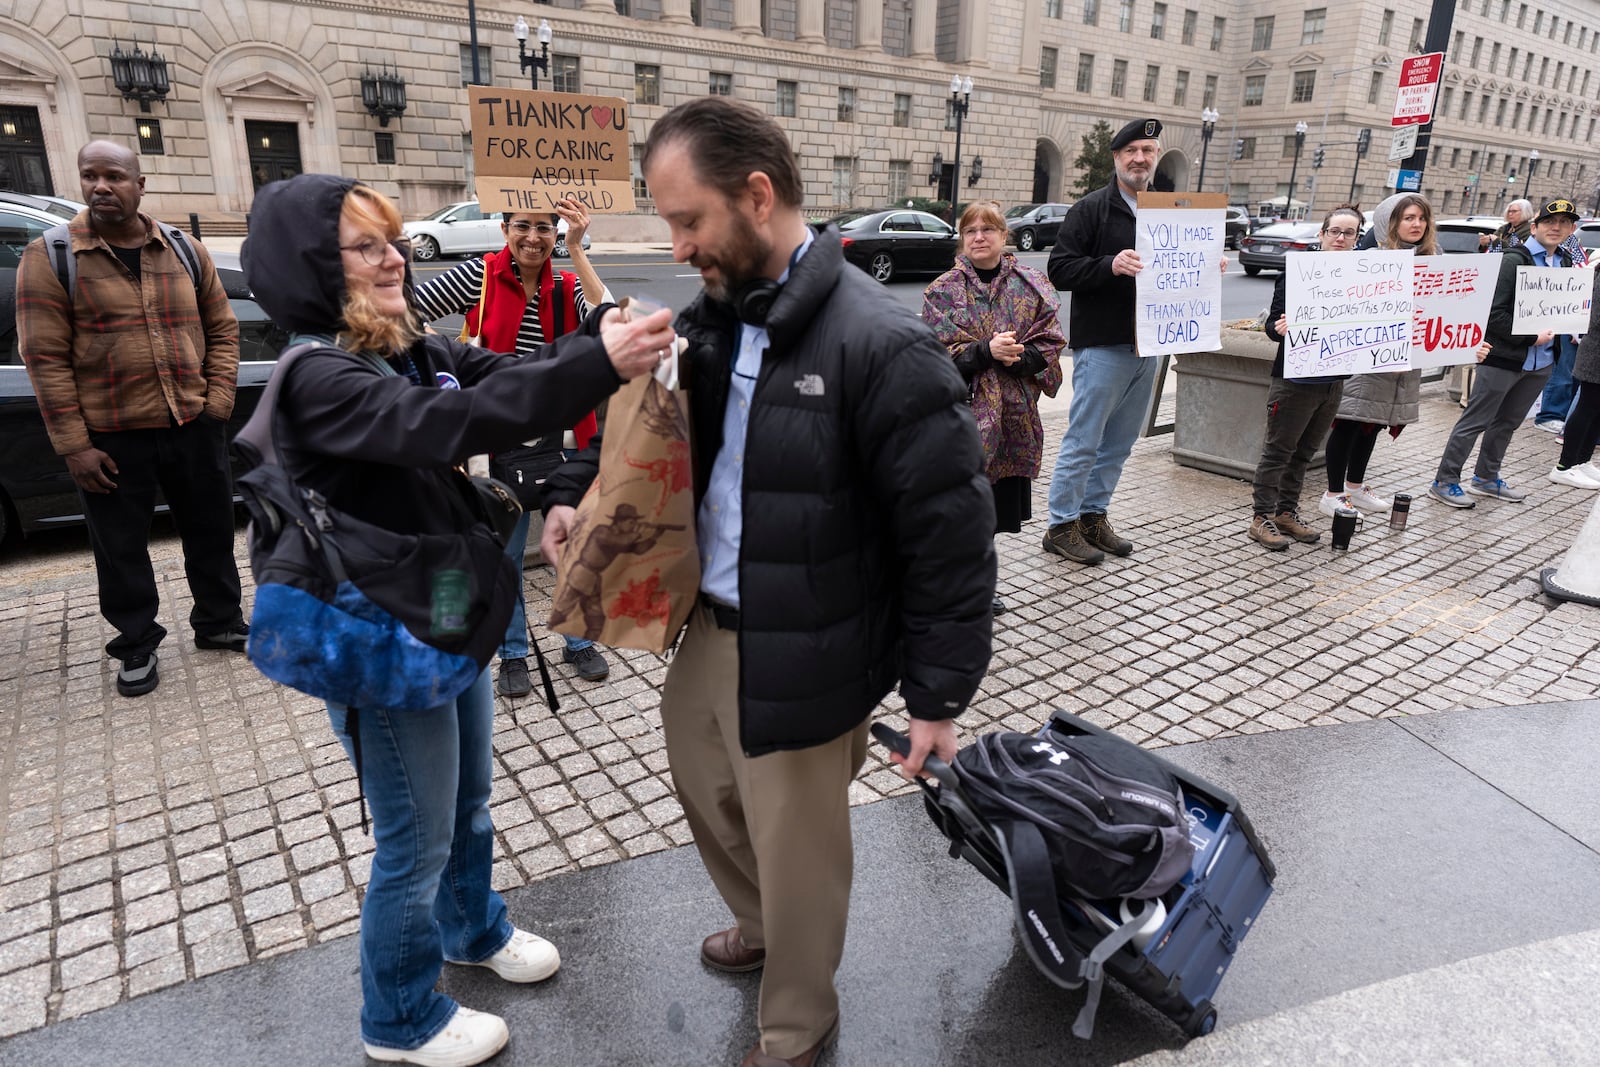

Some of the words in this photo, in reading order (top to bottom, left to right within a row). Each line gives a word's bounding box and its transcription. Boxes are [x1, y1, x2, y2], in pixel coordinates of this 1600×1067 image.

[1408, 66, 1432, 76] EMERGENCY
[1413, 57, 1431, 68] SNOW
[1408, 74, 1429, 84] ROUTE
[1402, 88, 1409, 96] NO
[1410, 85, 1431, 95] PARKING
[1405, 96, 1424, 105] DURING
[1399, 105, 1426, 115] EMERGENCY
[486, 137, 531, 159] FOR
[536, 138, 614, 162] CARING
[532, 167, 600, 186] ABOUT
[500, 189, 542, 209] THE
[1147, 223, 1179, 250] YOU
[1184, 227, 1214, 241] MADE
[1152, 251, 1206, 269] AMERICA
[1297, 260, 1343, 282] We're
[1357, 258, 1403, 280] Sorry
[1156, 270, 1200, 290] GREAT!
[1308, 285, 1344, 300] These
[1347, 280, 1404, 300] FUCKERS
[1520, 271, 1543, 291] Thank
[1545, 277, 1563, 292] You
[1146, 302, 1185, 320] THANK
[1189, 300, 1211, 318] YOU
[1295, 305, 1317, 323] ARE
[1322, 304, 1358, 320] DOING
[1359, 300, 1379, 315] This
[1393, 300, 1411, 315] YOU
[1158, 320, 1200, 345] USAID
[1288, 327, 1320, 349] WE
[1320, 322, 1406, 359] APPRECIATE
[1424, 316, 1482, 352] USAID
[1371, 341, 1409, 366] YOU!!
